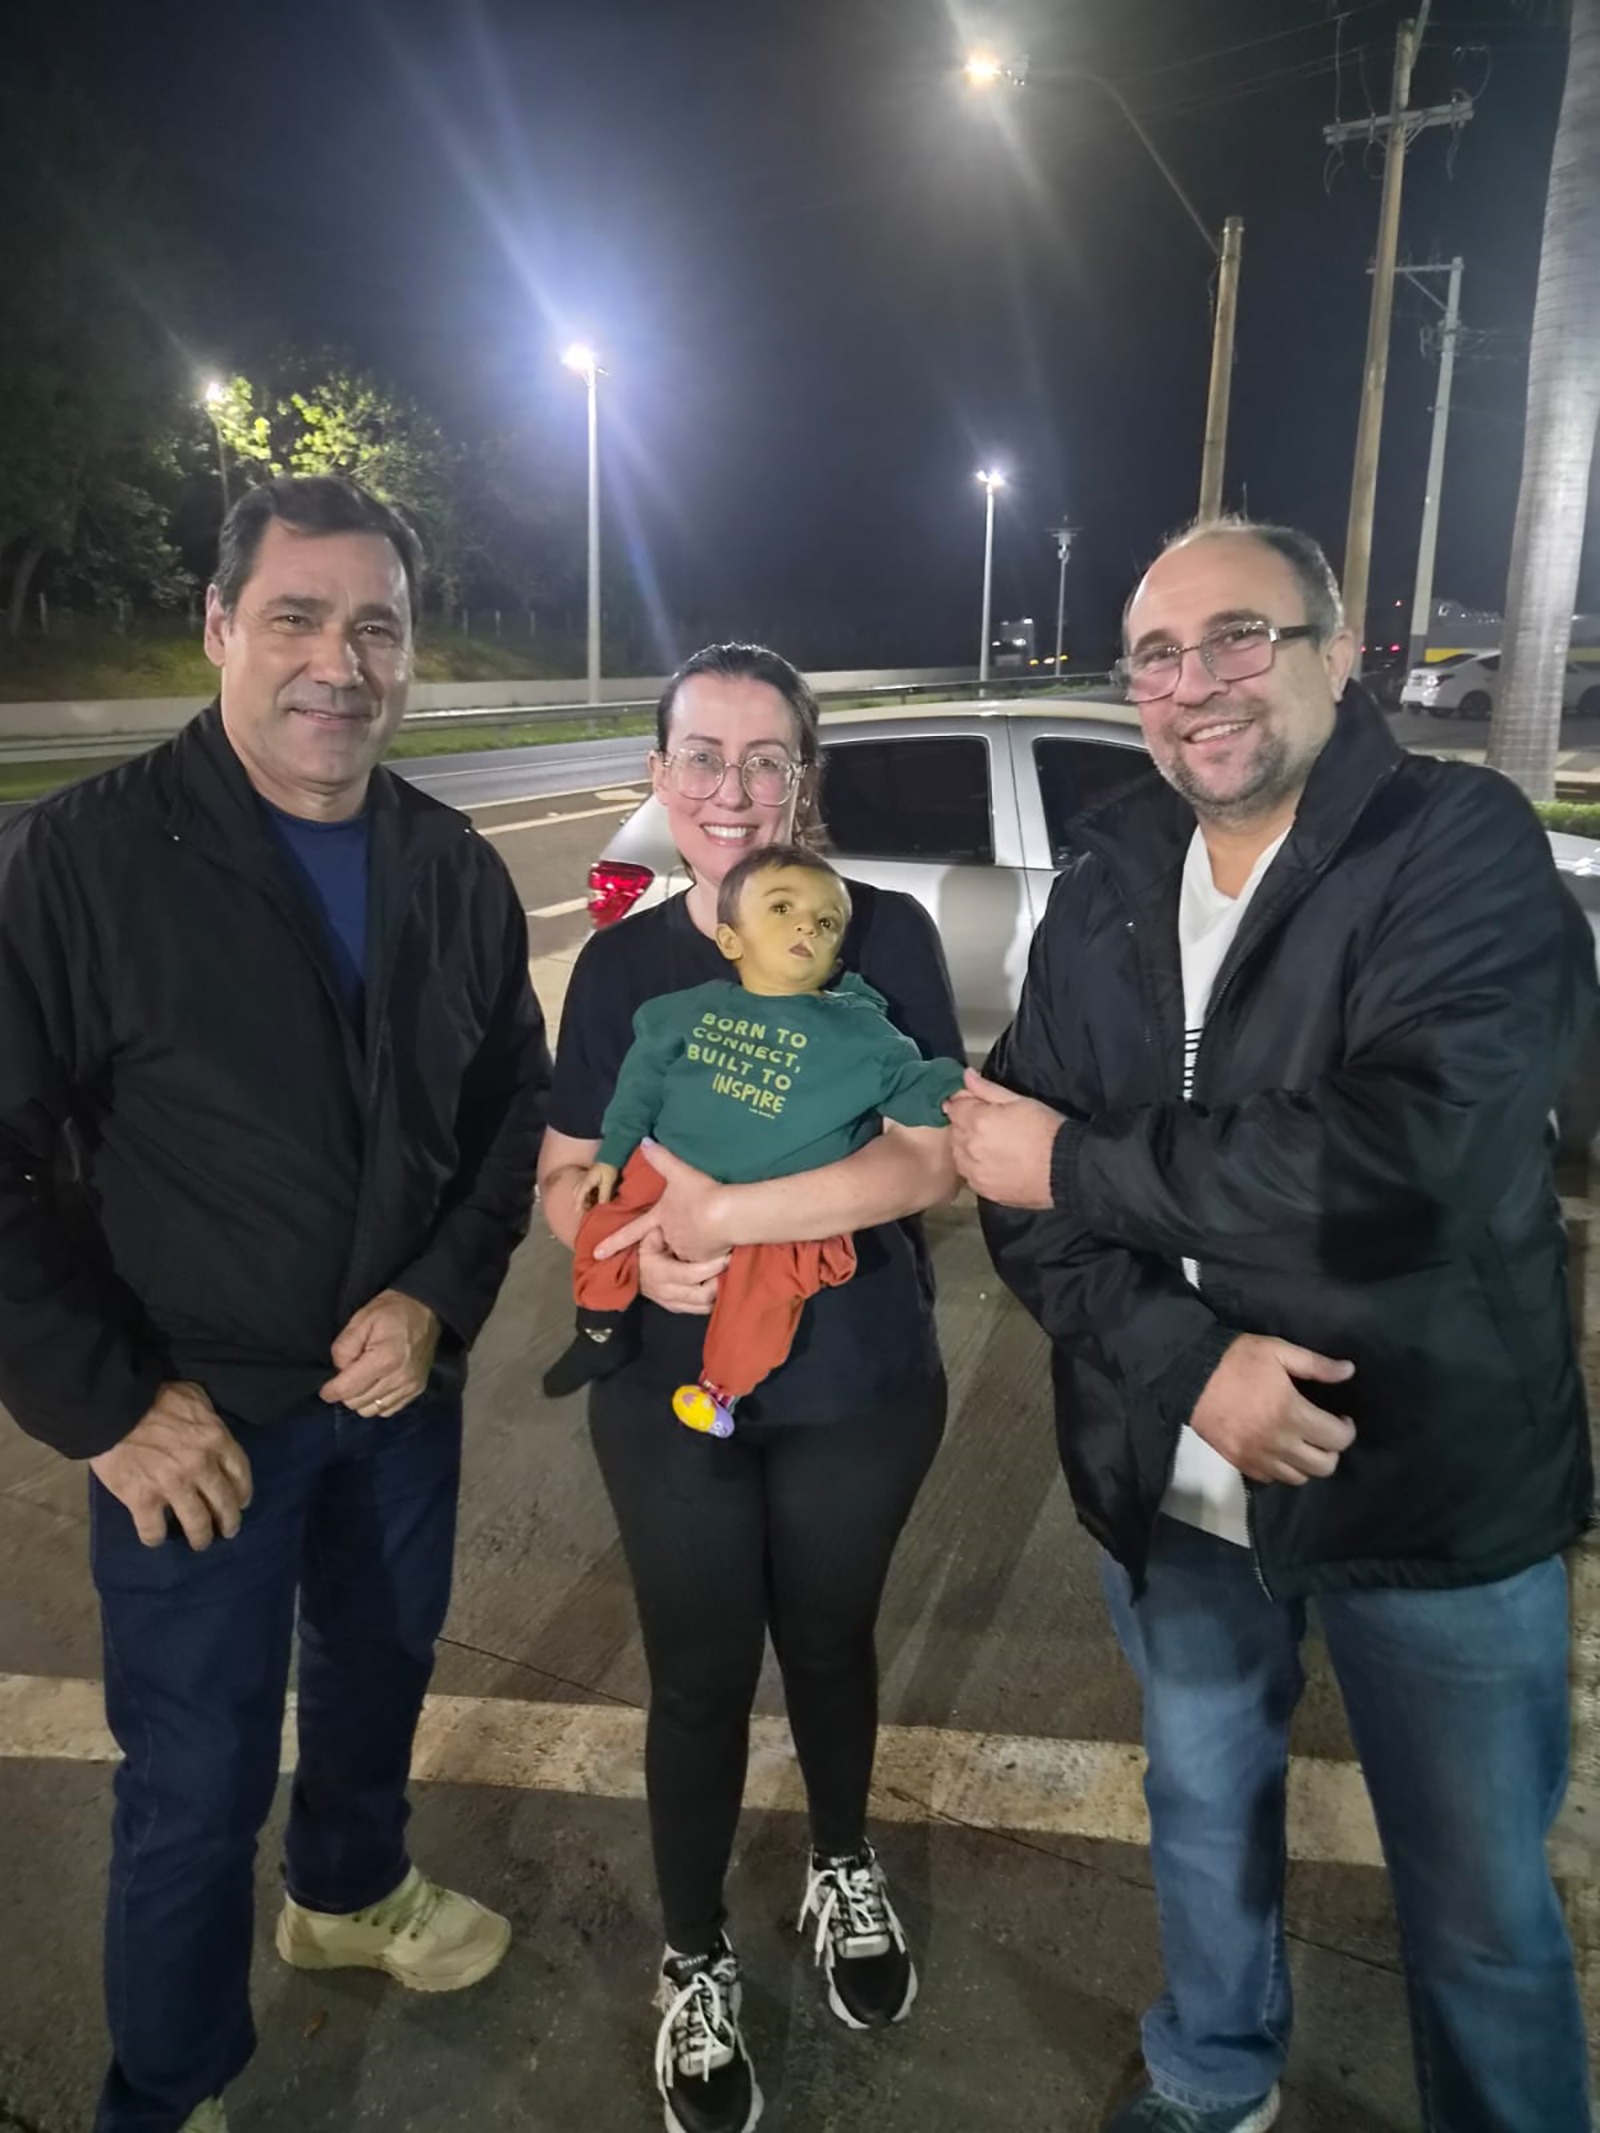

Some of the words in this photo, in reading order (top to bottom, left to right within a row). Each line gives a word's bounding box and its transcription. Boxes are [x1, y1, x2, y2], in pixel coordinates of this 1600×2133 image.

[693, 1027, 800, 1073] CONNECT,
[702, 1012, 766, 1039] BORN
[777, 1028, 808, 1049] TO
[687, 1043, 753, 1075] BUILT
[762, 1068, 792, 1090] TO
[712, 1072, 786, 1113] INSPIRE
